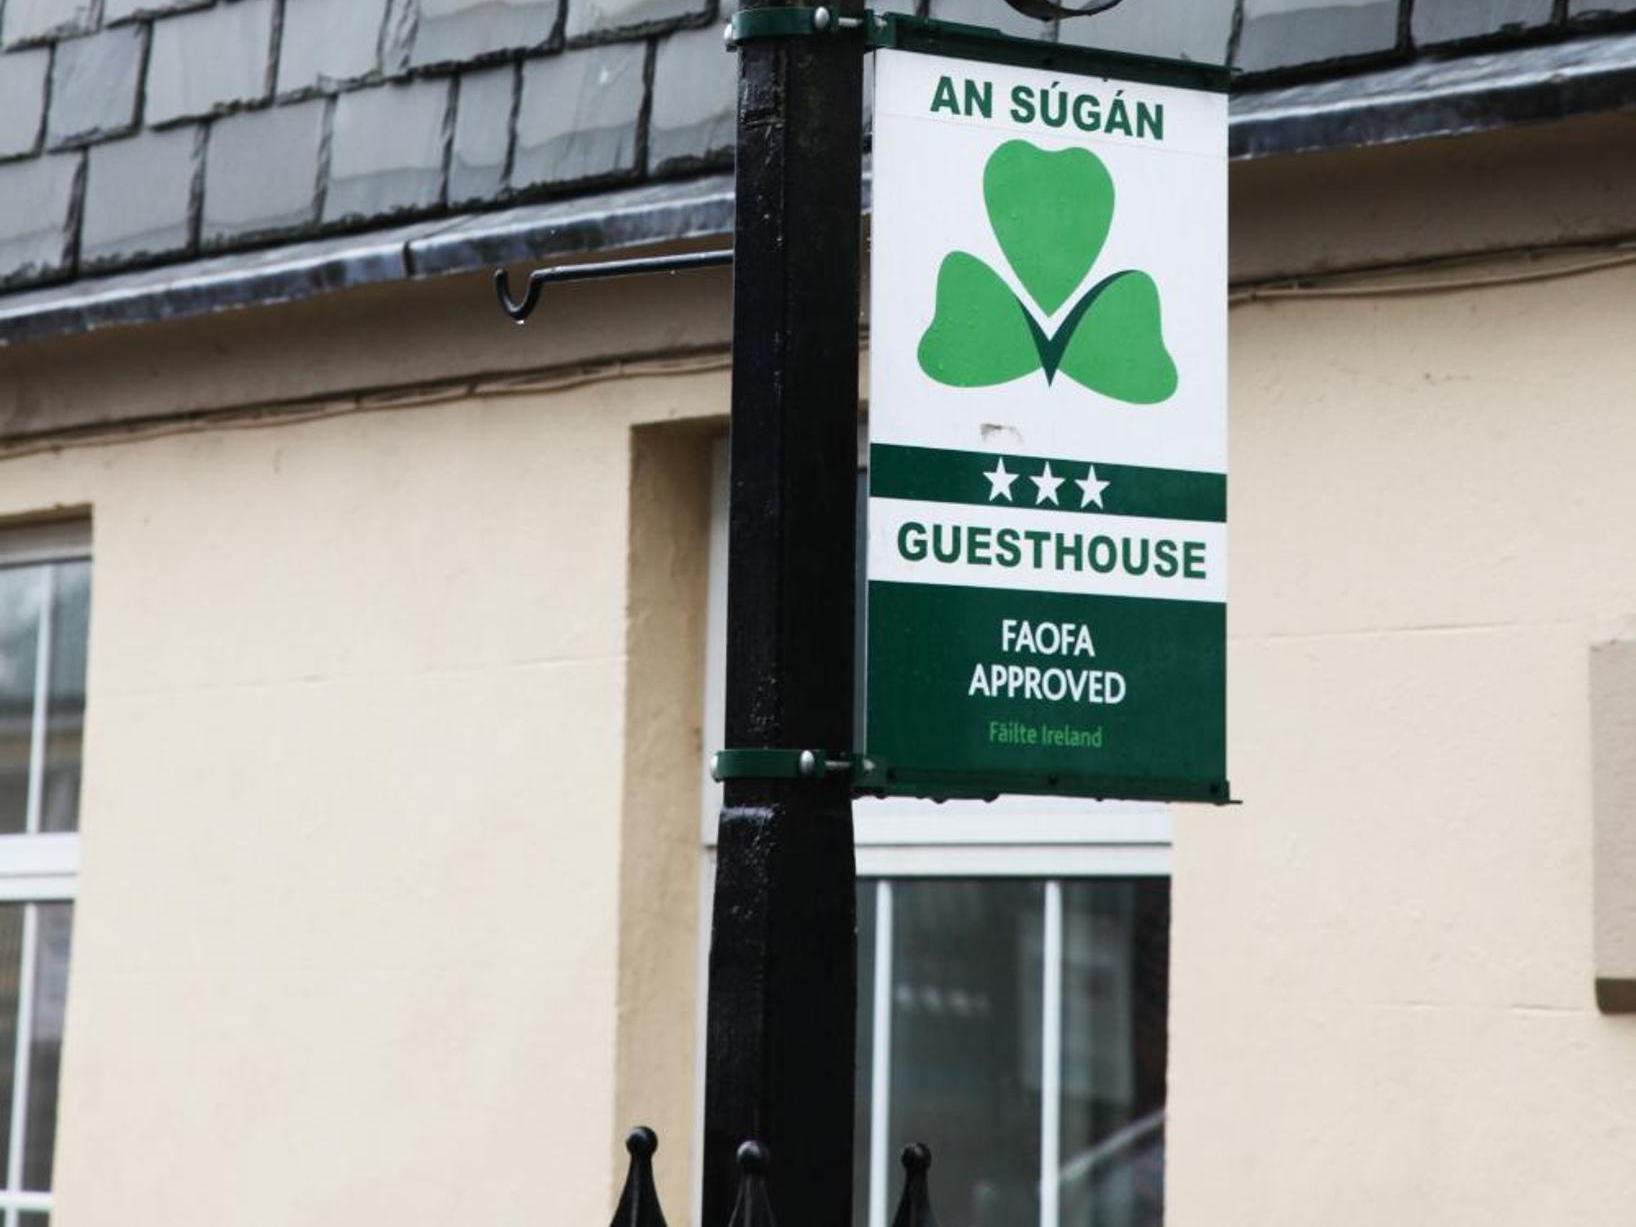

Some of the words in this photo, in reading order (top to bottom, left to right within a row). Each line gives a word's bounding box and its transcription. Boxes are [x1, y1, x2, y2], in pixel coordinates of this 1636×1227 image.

[930, 75, 993, 119] AN
[1010, 81, 1164, 140] SÚGÁN
[897, 521, 1207, 580] GUESTHOUSE
[1001, 619, 1095, 657] FAOFA
[968, 663, 1126, 705] APPROVED
[1041, 725, 1103, 748] Ireland
